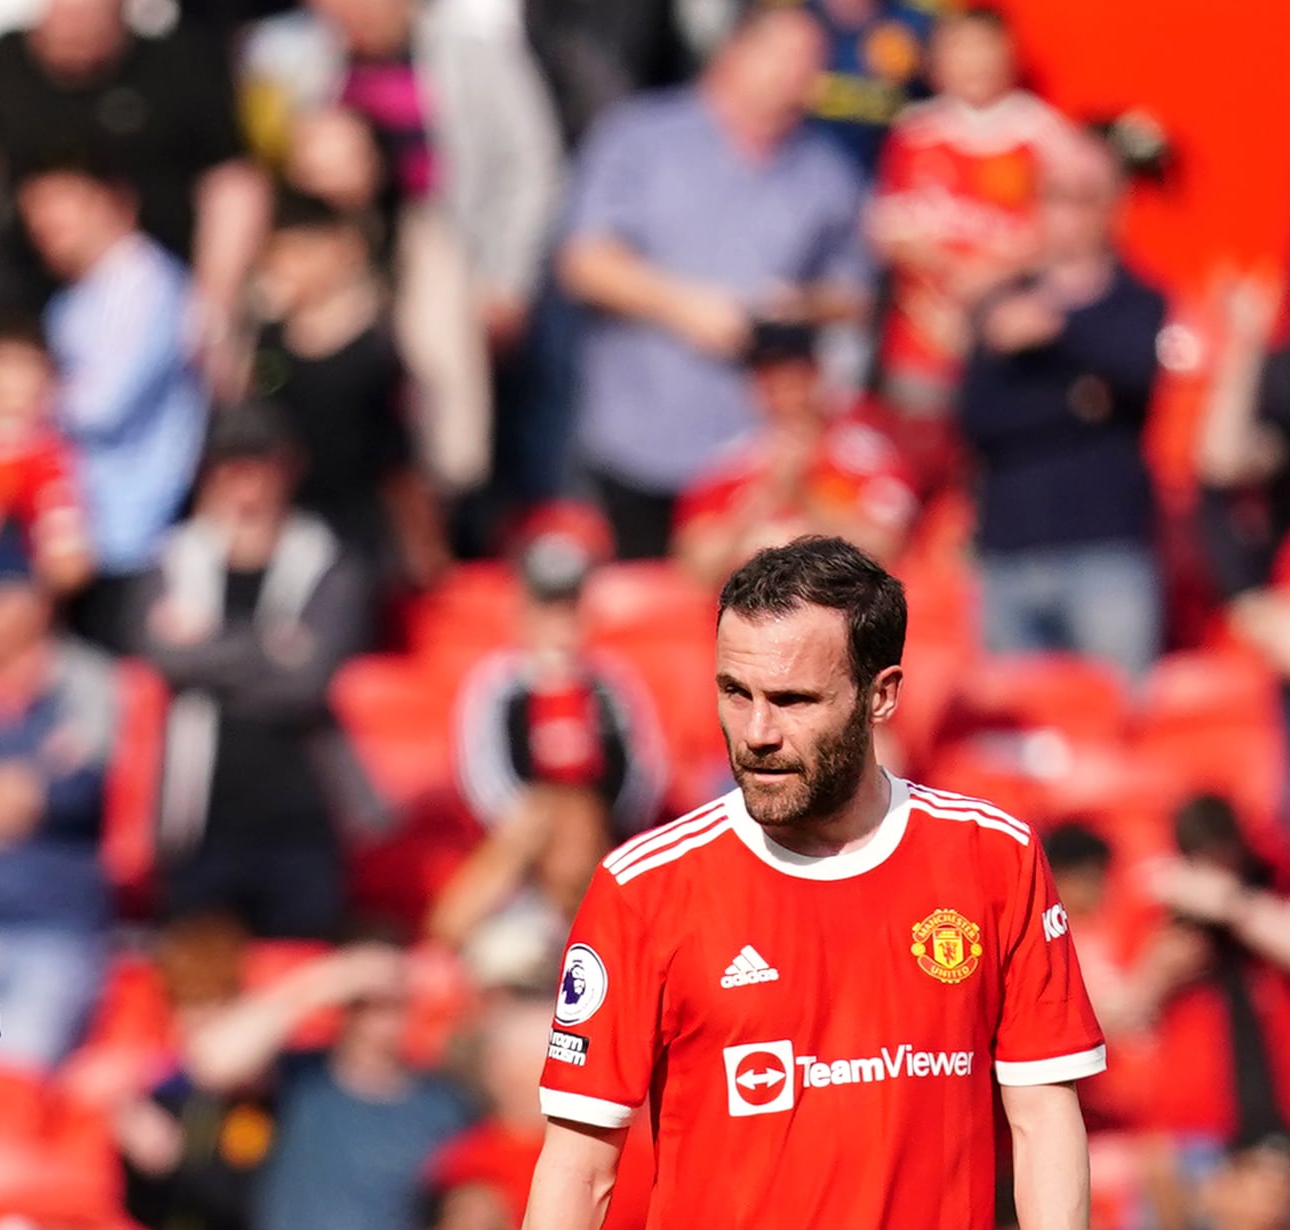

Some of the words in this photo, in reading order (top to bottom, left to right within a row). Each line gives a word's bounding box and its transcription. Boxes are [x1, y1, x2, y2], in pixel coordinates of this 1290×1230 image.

[917, 913, 978, 940] MANCHESTER
[720, 967, 780, 989] adidas
[929, 964, 971, 980] UNITED
[795, 1043, 974, 1089] TeamViewer
